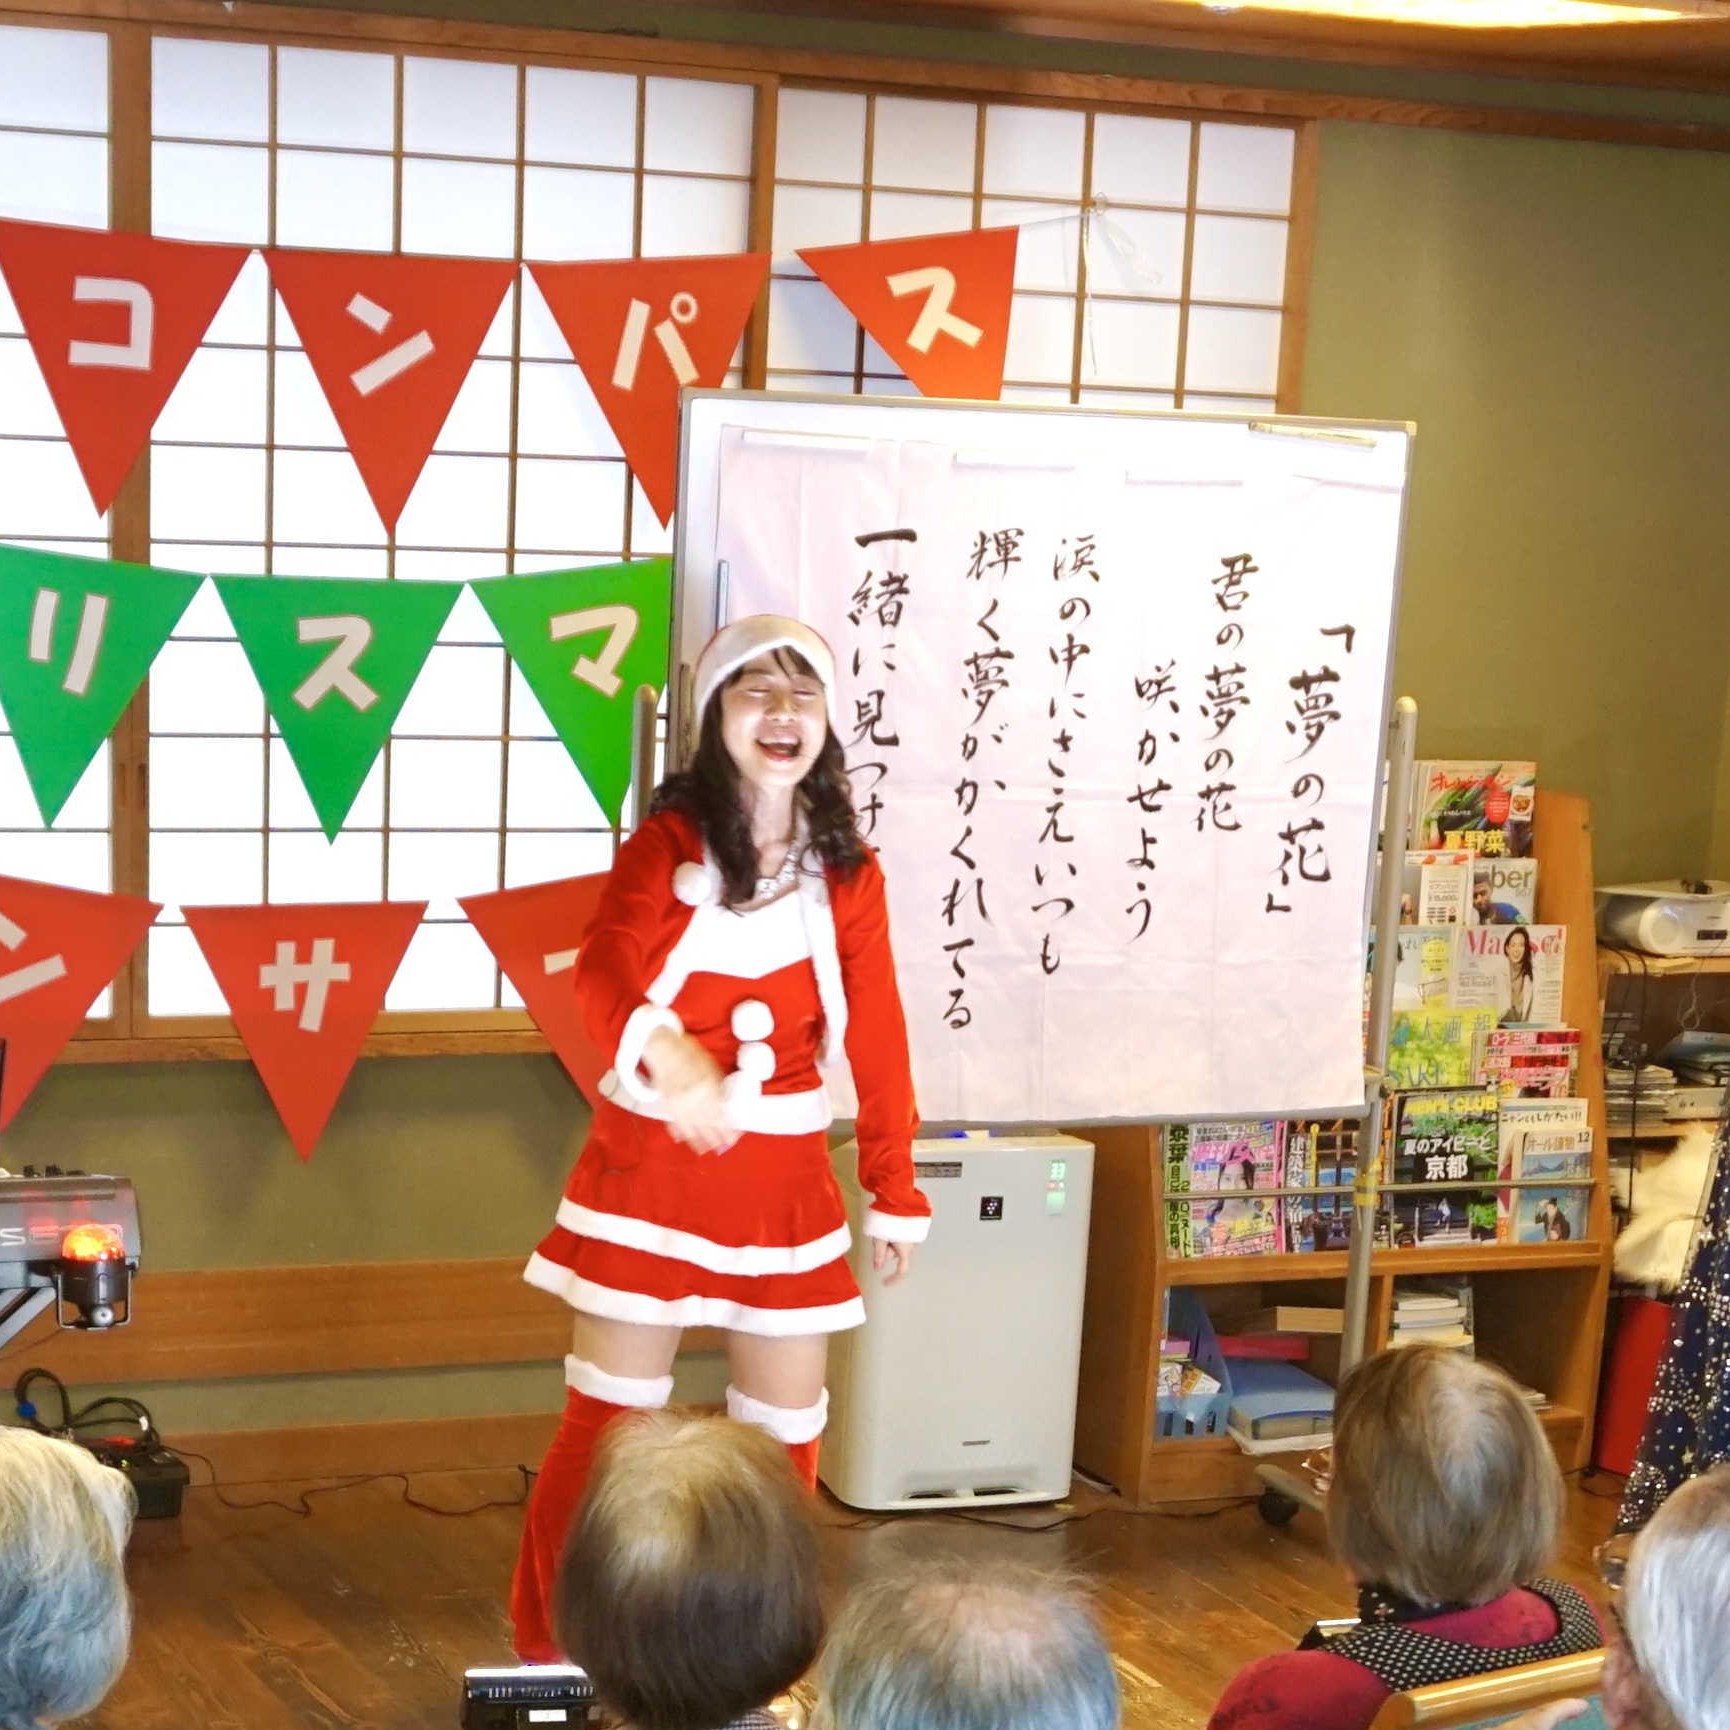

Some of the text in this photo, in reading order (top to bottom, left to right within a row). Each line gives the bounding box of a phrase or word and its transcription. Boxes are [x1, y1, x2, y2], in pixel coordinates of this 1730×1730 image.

[843, 527, 919, 853] 一緒に見つけ
[940, 526, 1026, 1031] 輝く夢がかくれてる
[1030, 532, 1102, 976] 涙の中にさえいつも
[1123, 658, 1181, 945] 咲かせよう
[1192, 553, 1260, 833] 君の夢の花
[1265, 623, 1356, 914] 「夢の花」
[1403, 1136, 1494, 1156] 夏のアイビーと
[1424, 1154, 1469, 1181] 京都
[1454, 1095, 1498, 1112] CLUB
[1577, 1131, 1591, 1143] 12
